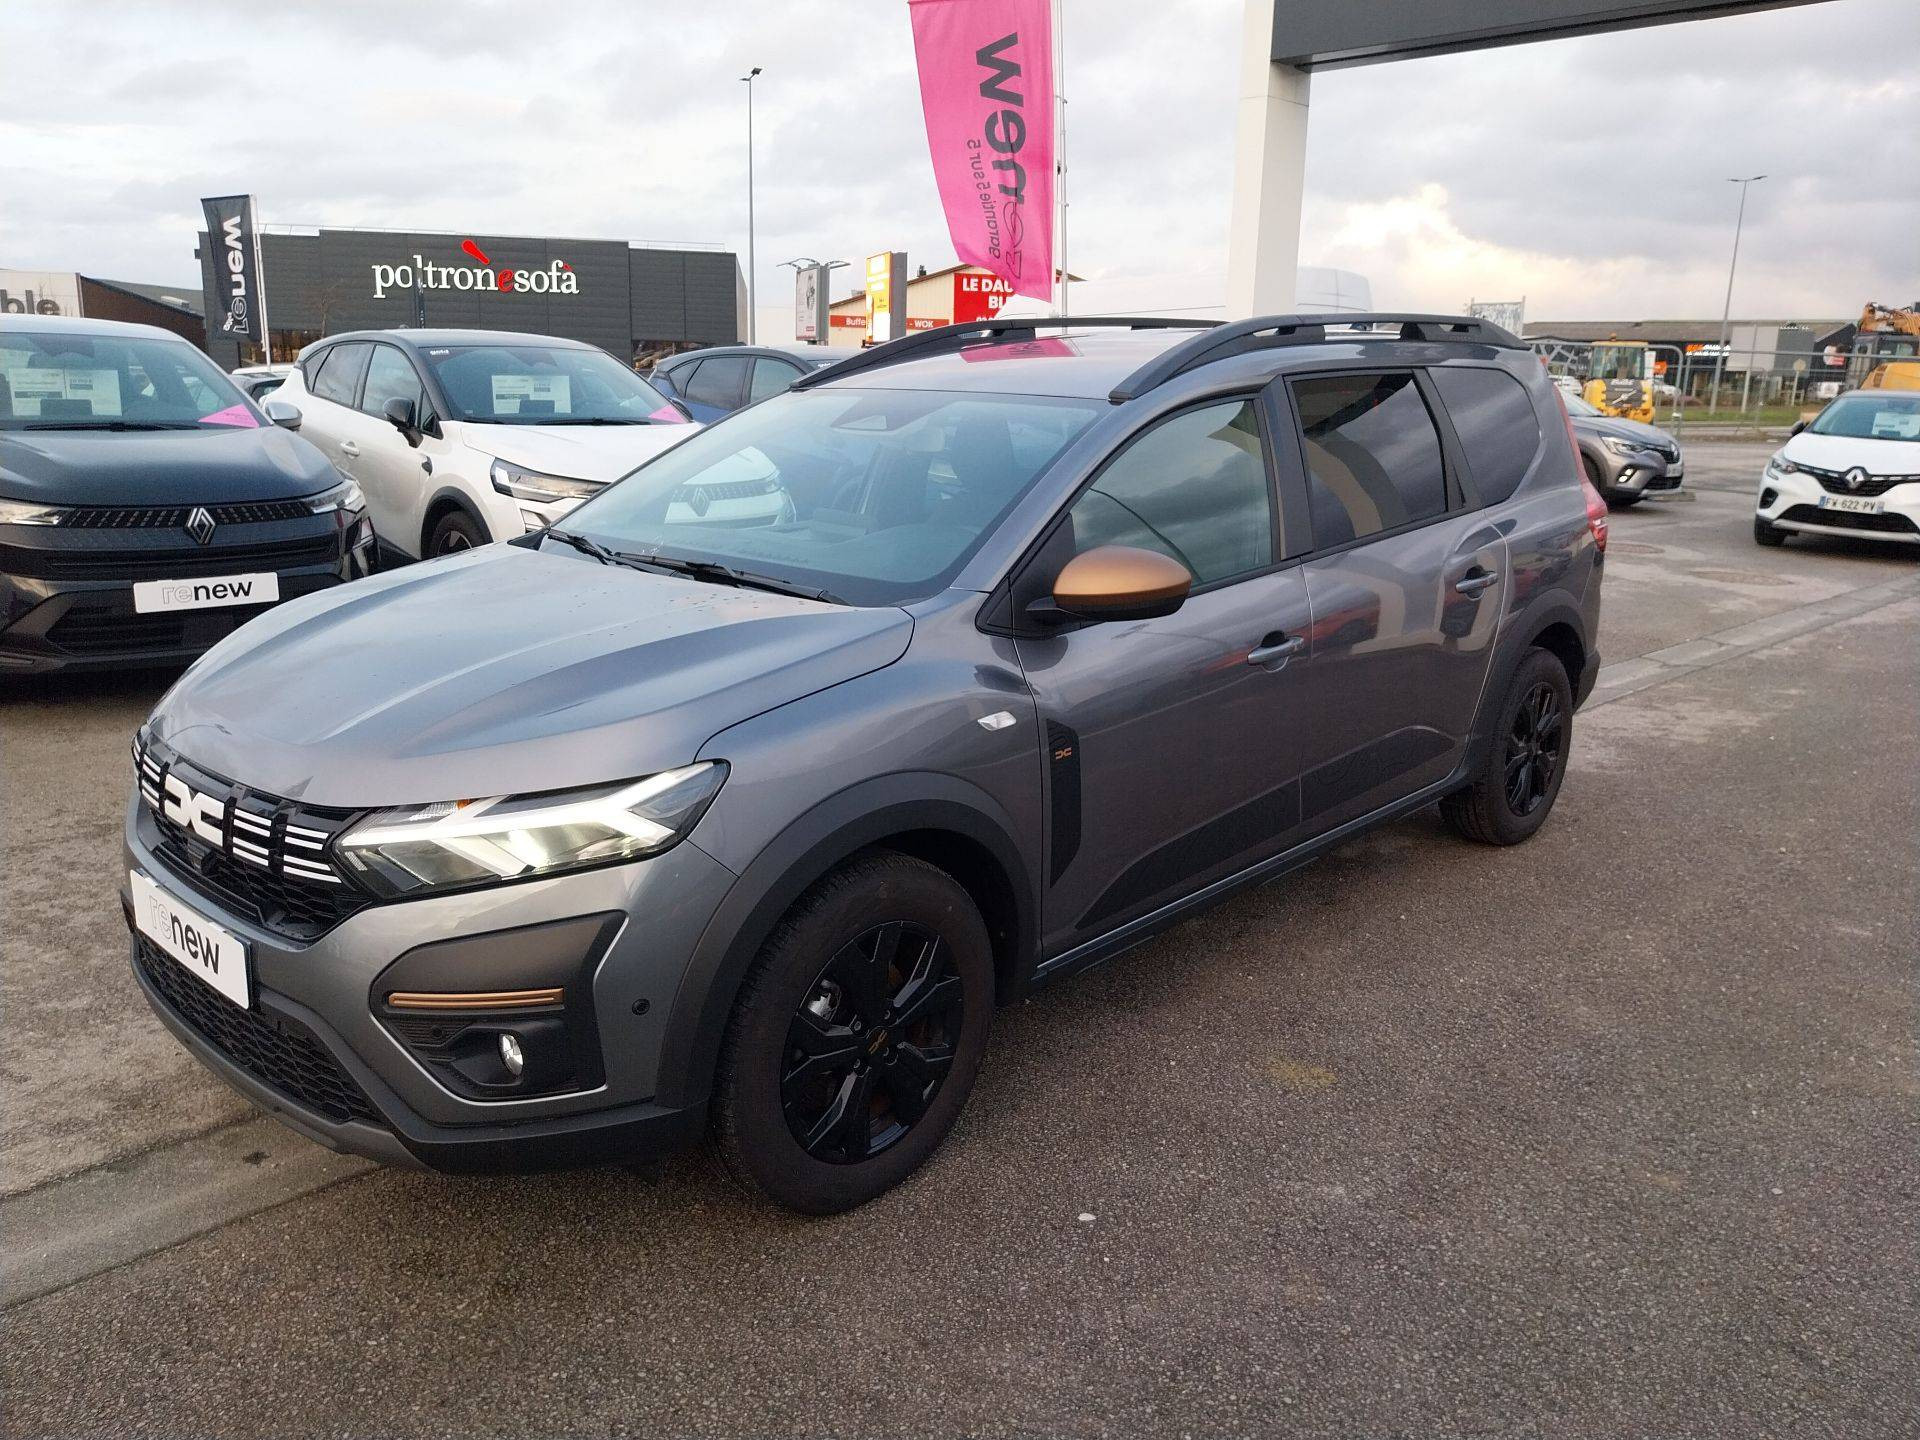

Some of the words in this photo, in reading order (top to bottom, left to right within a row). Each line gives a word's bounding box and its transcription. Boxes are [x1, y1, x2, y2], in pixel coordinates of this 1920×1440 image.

[962, 277, 979, 292] LE
[914, 320, 934, 328] WOK
[161, 580, 253, 605] renew
[149, 895, 220, 975] renew
